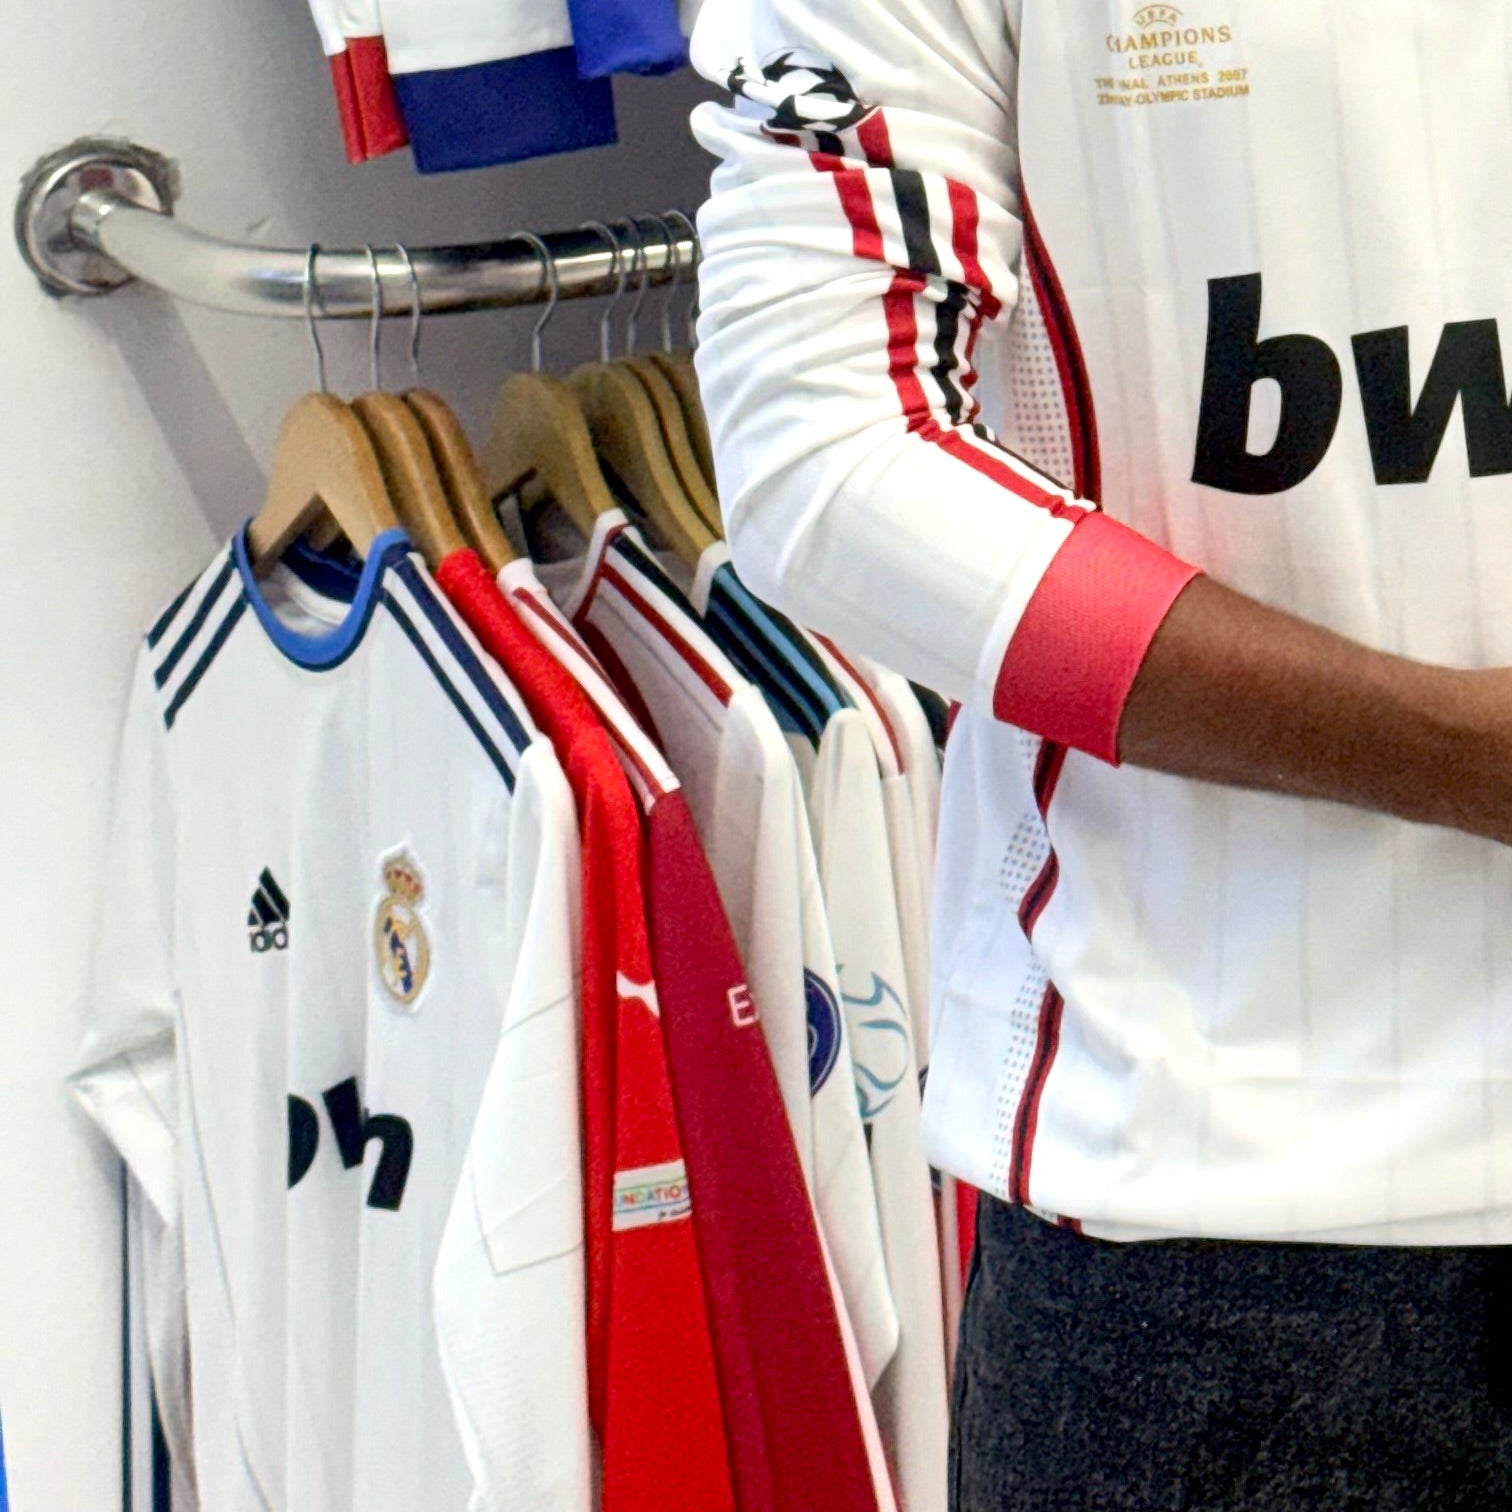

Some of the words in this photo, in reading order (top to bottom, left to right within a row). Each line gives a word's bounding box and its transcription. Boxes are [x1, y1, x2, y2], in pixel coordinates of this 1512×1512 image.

[1135, 8, 1178, 27] UEFA
[1128, 50, 1200, 70] LEAGUE
[1157, 70, 1210, 87] ATHENS
[1192, 84, 1251, 102] STADIUM
